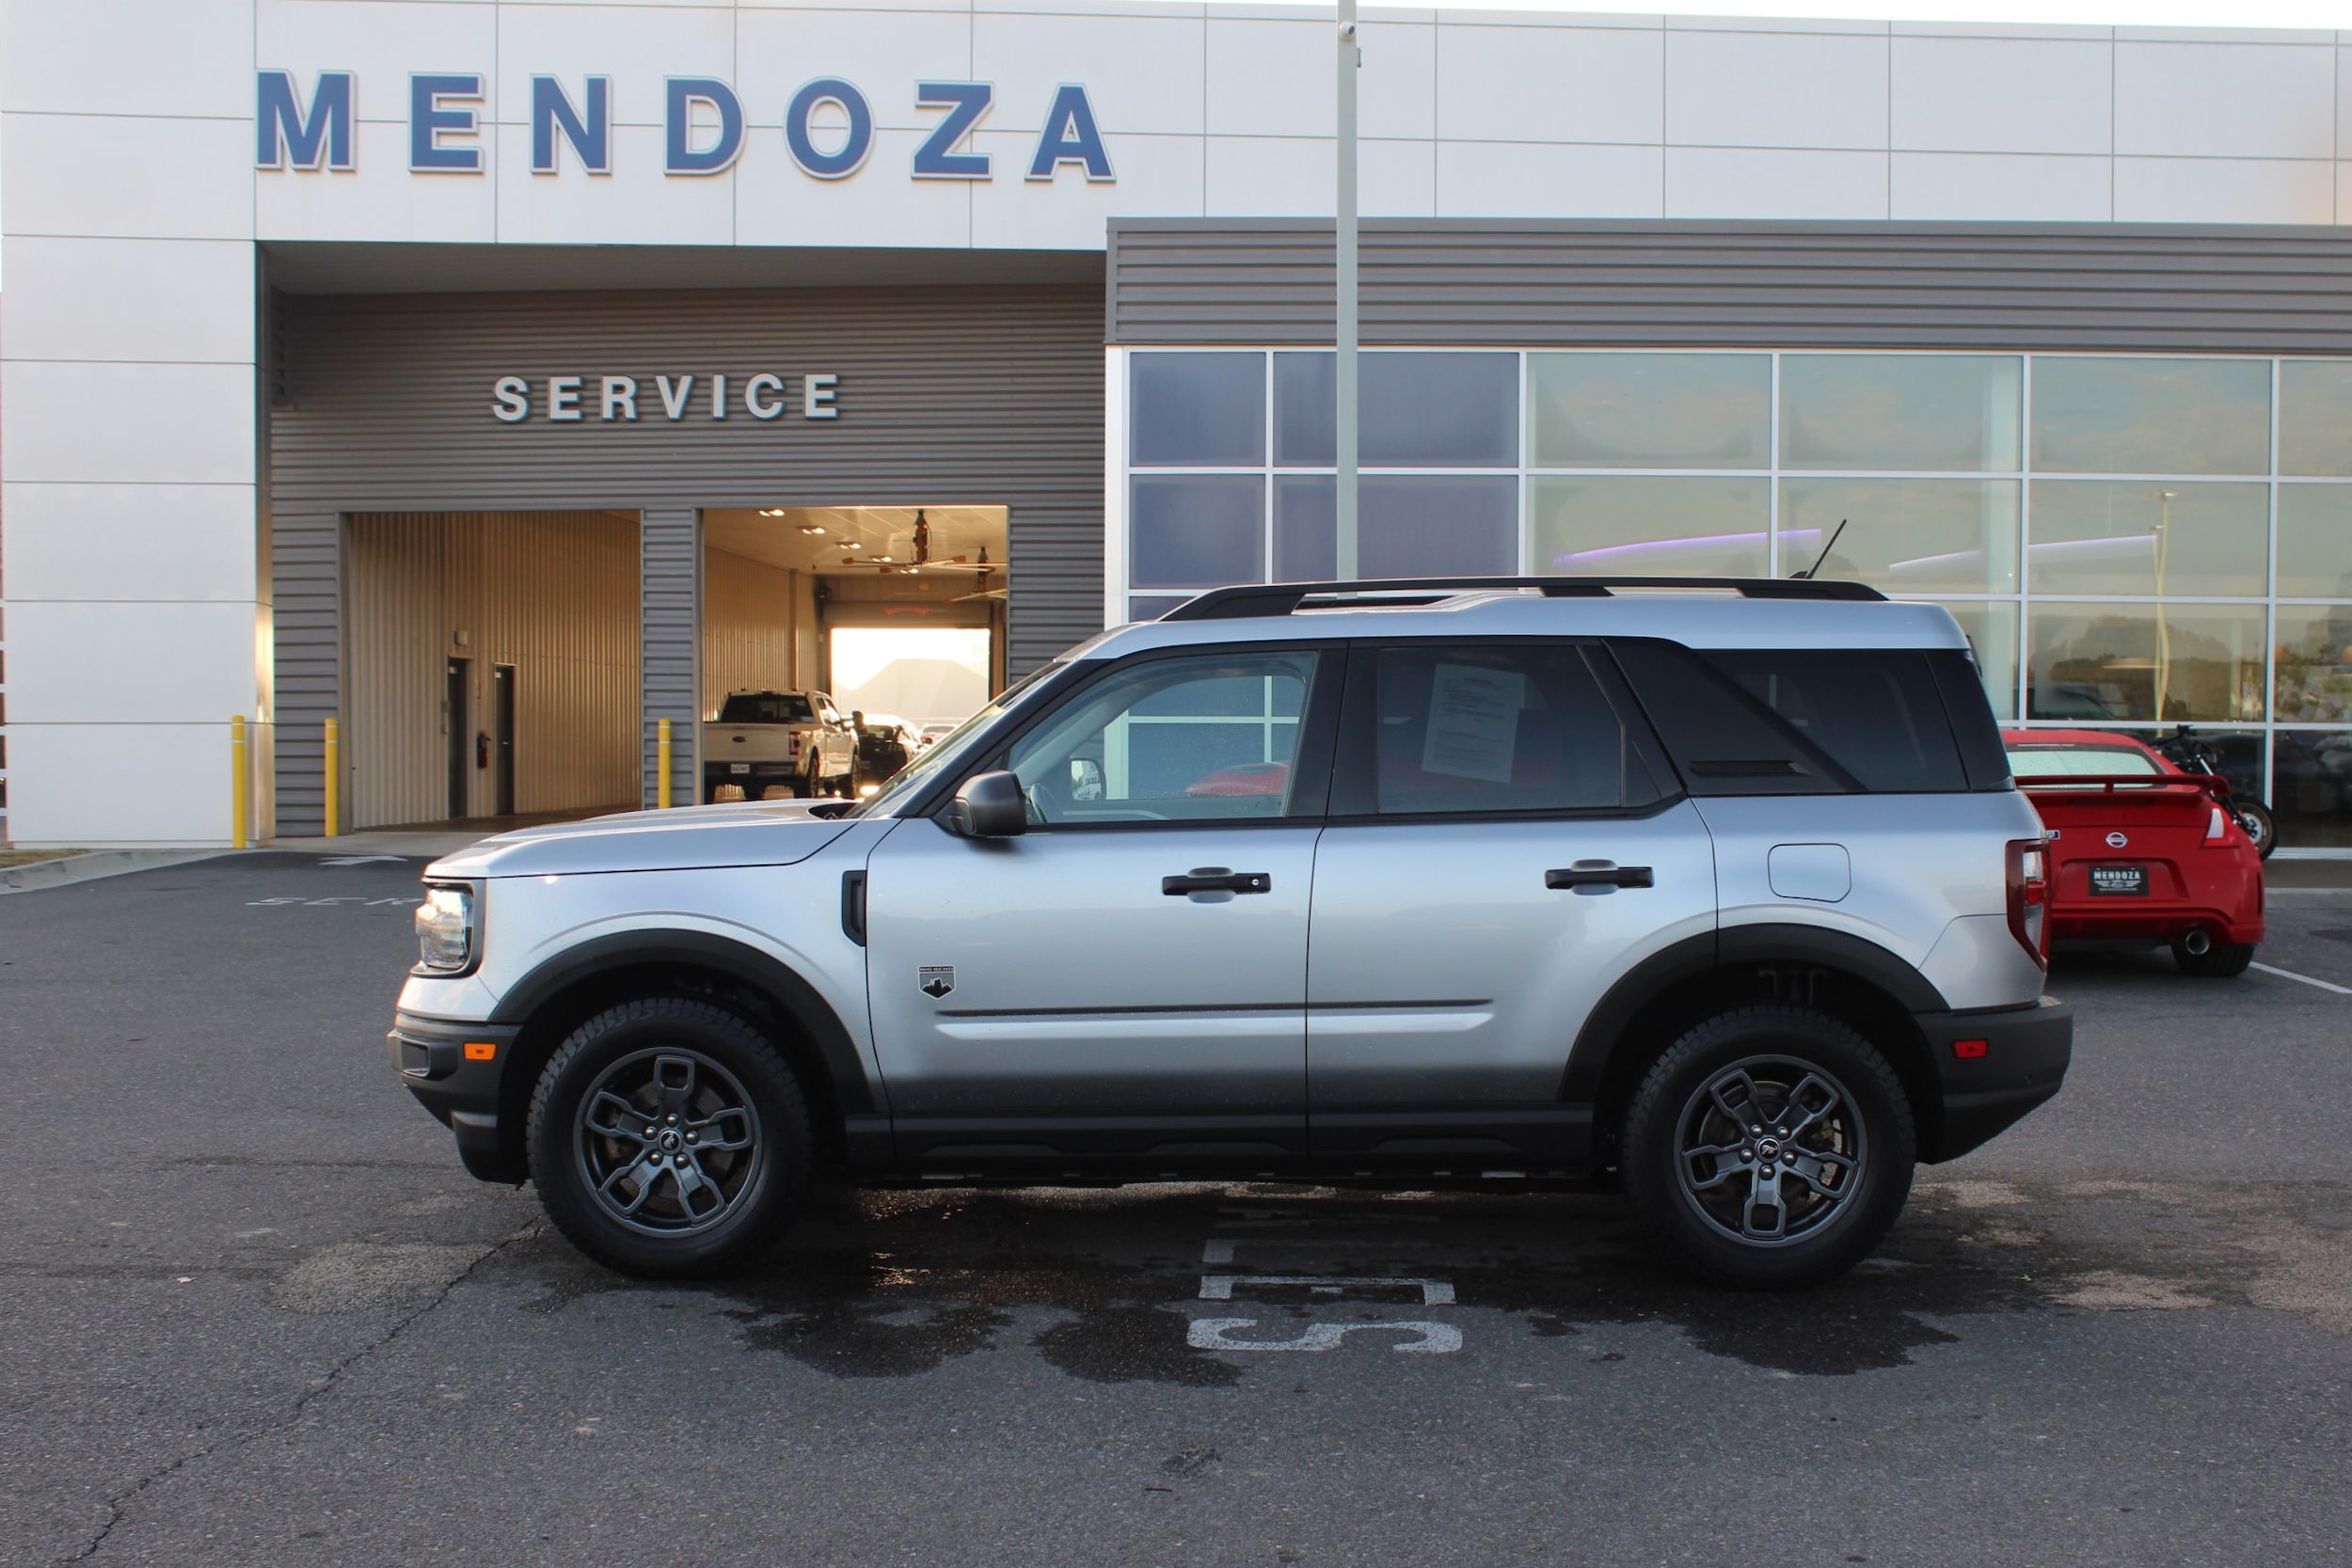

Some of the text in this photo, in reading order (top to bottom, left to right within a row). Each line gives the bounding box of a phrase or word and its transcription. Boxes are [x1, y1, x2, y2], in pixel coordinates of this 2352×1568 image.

[255, 68, 1117, 182] MENDOZA
[492, 373, 840, 422] SERVICE
[2093, 871, 2141, 879] MENDOZA
